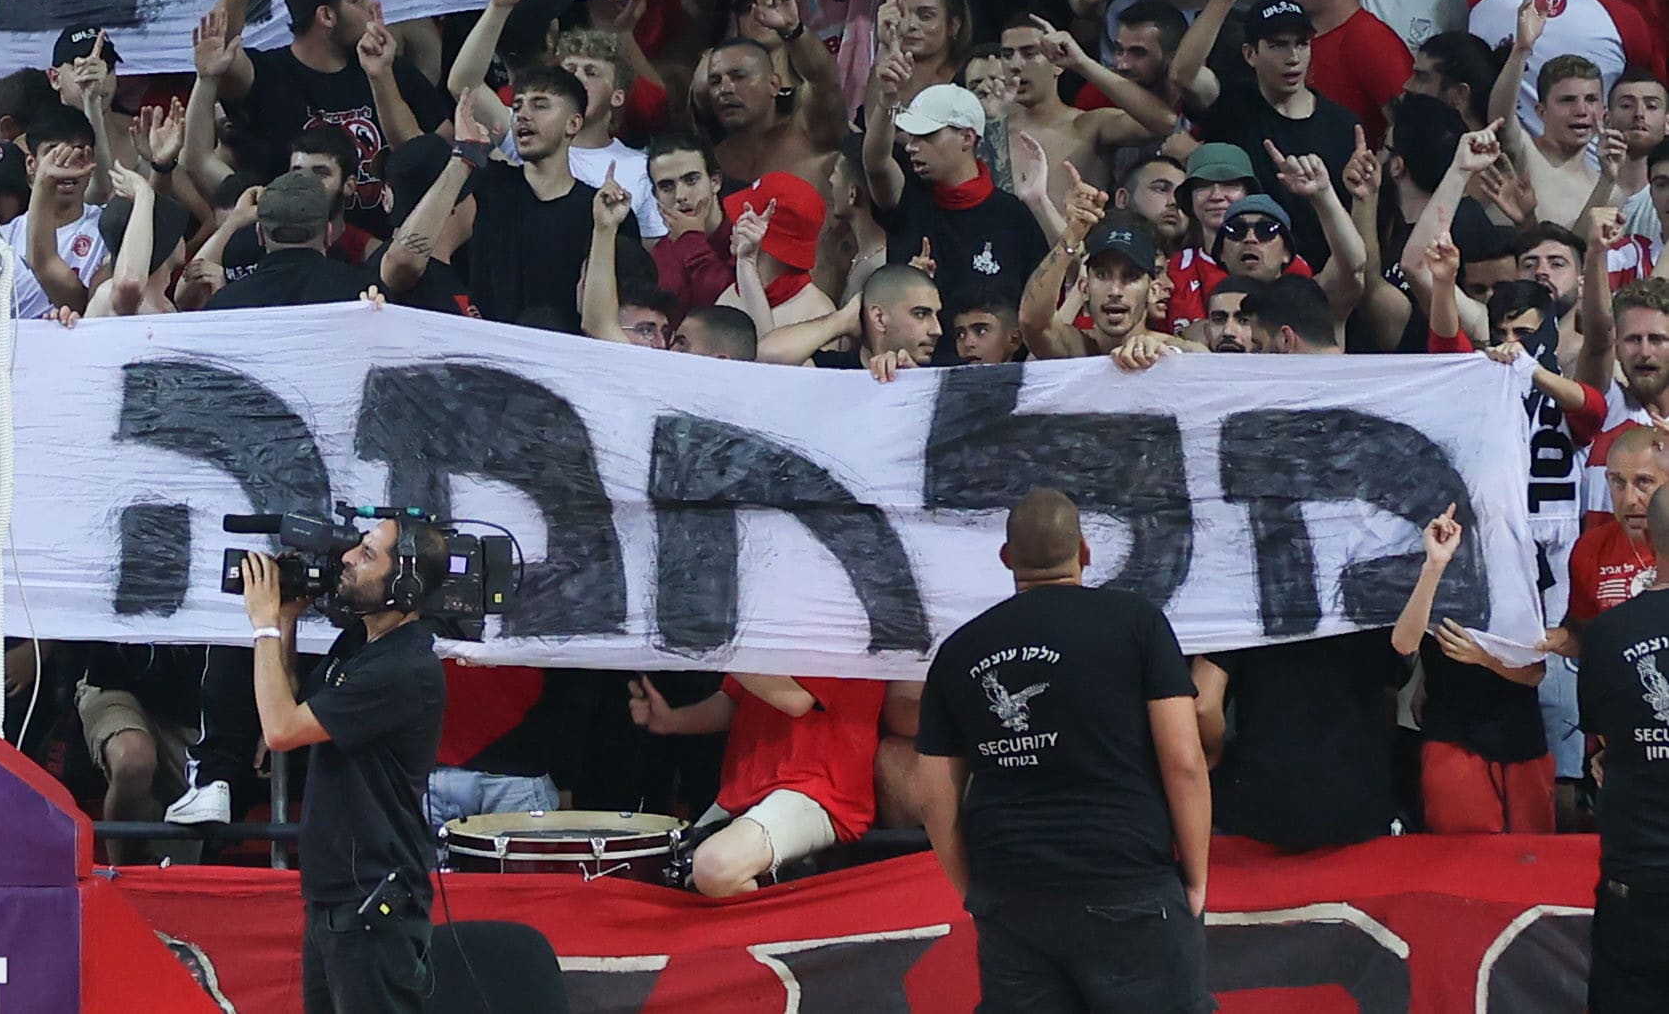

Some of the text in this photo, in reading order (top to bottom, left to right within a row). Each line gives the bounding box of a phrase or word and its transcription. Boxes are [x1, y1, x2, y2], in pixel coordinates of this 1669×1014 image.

[113, 359, 1490, 654] מלחמה
[969, 647, 1017, 679] עוצמה
[977, 731, 1059, 756] SECURITY
